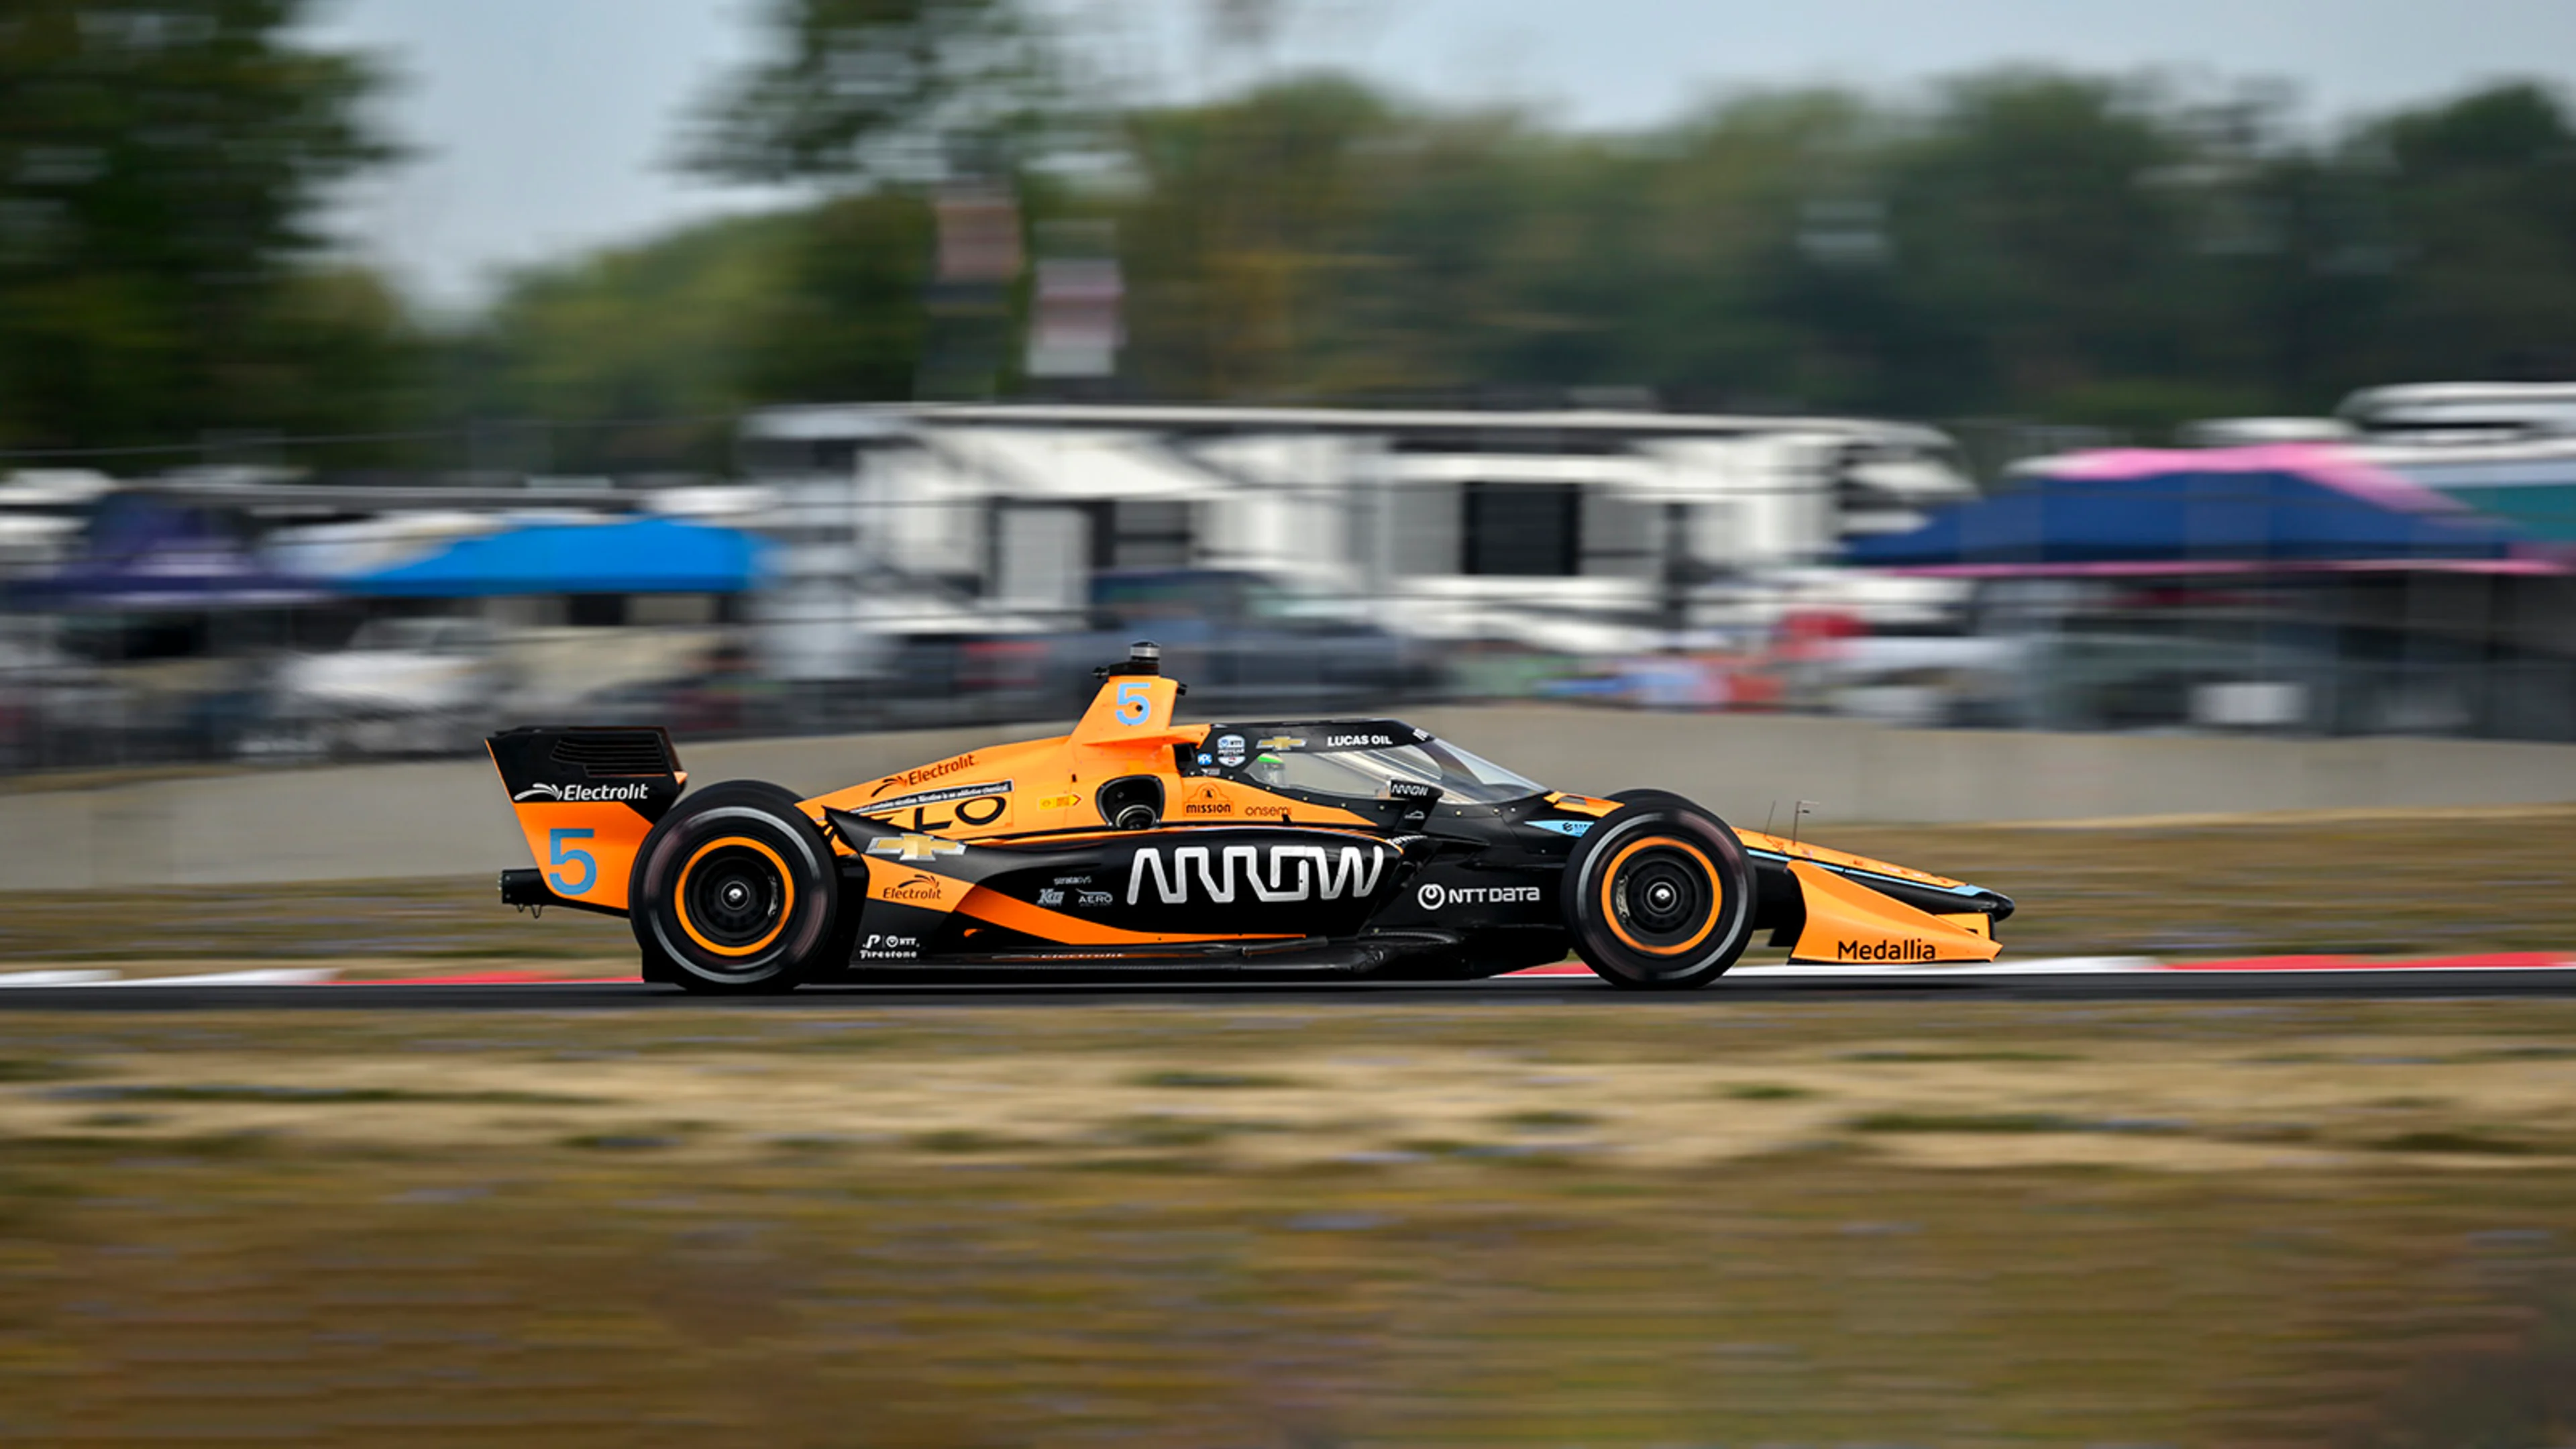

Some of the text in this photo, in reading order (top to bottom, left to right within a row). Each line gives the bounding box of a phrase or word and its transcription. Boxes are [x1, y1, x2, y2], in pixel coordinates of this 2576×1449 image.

[1115, 683, 1152, 725] 5
[1328, 735, 1392, 747] LUCAS OIL
[908, 753, 975, 786] Electrolit
[564, 783, 648, 801] Electrolit
[548, 828, 597, 896] 5
[1126, 845, 1384, 906] ARROW
[883, 887, 941, 900] Electrolit
[1078, 894, 1114, 904] AERO
[1449, 888, 1487, 904] NTT
[859, 950, 917, 960] Firestone
[1837, 938, 1936, 961] Medallia
